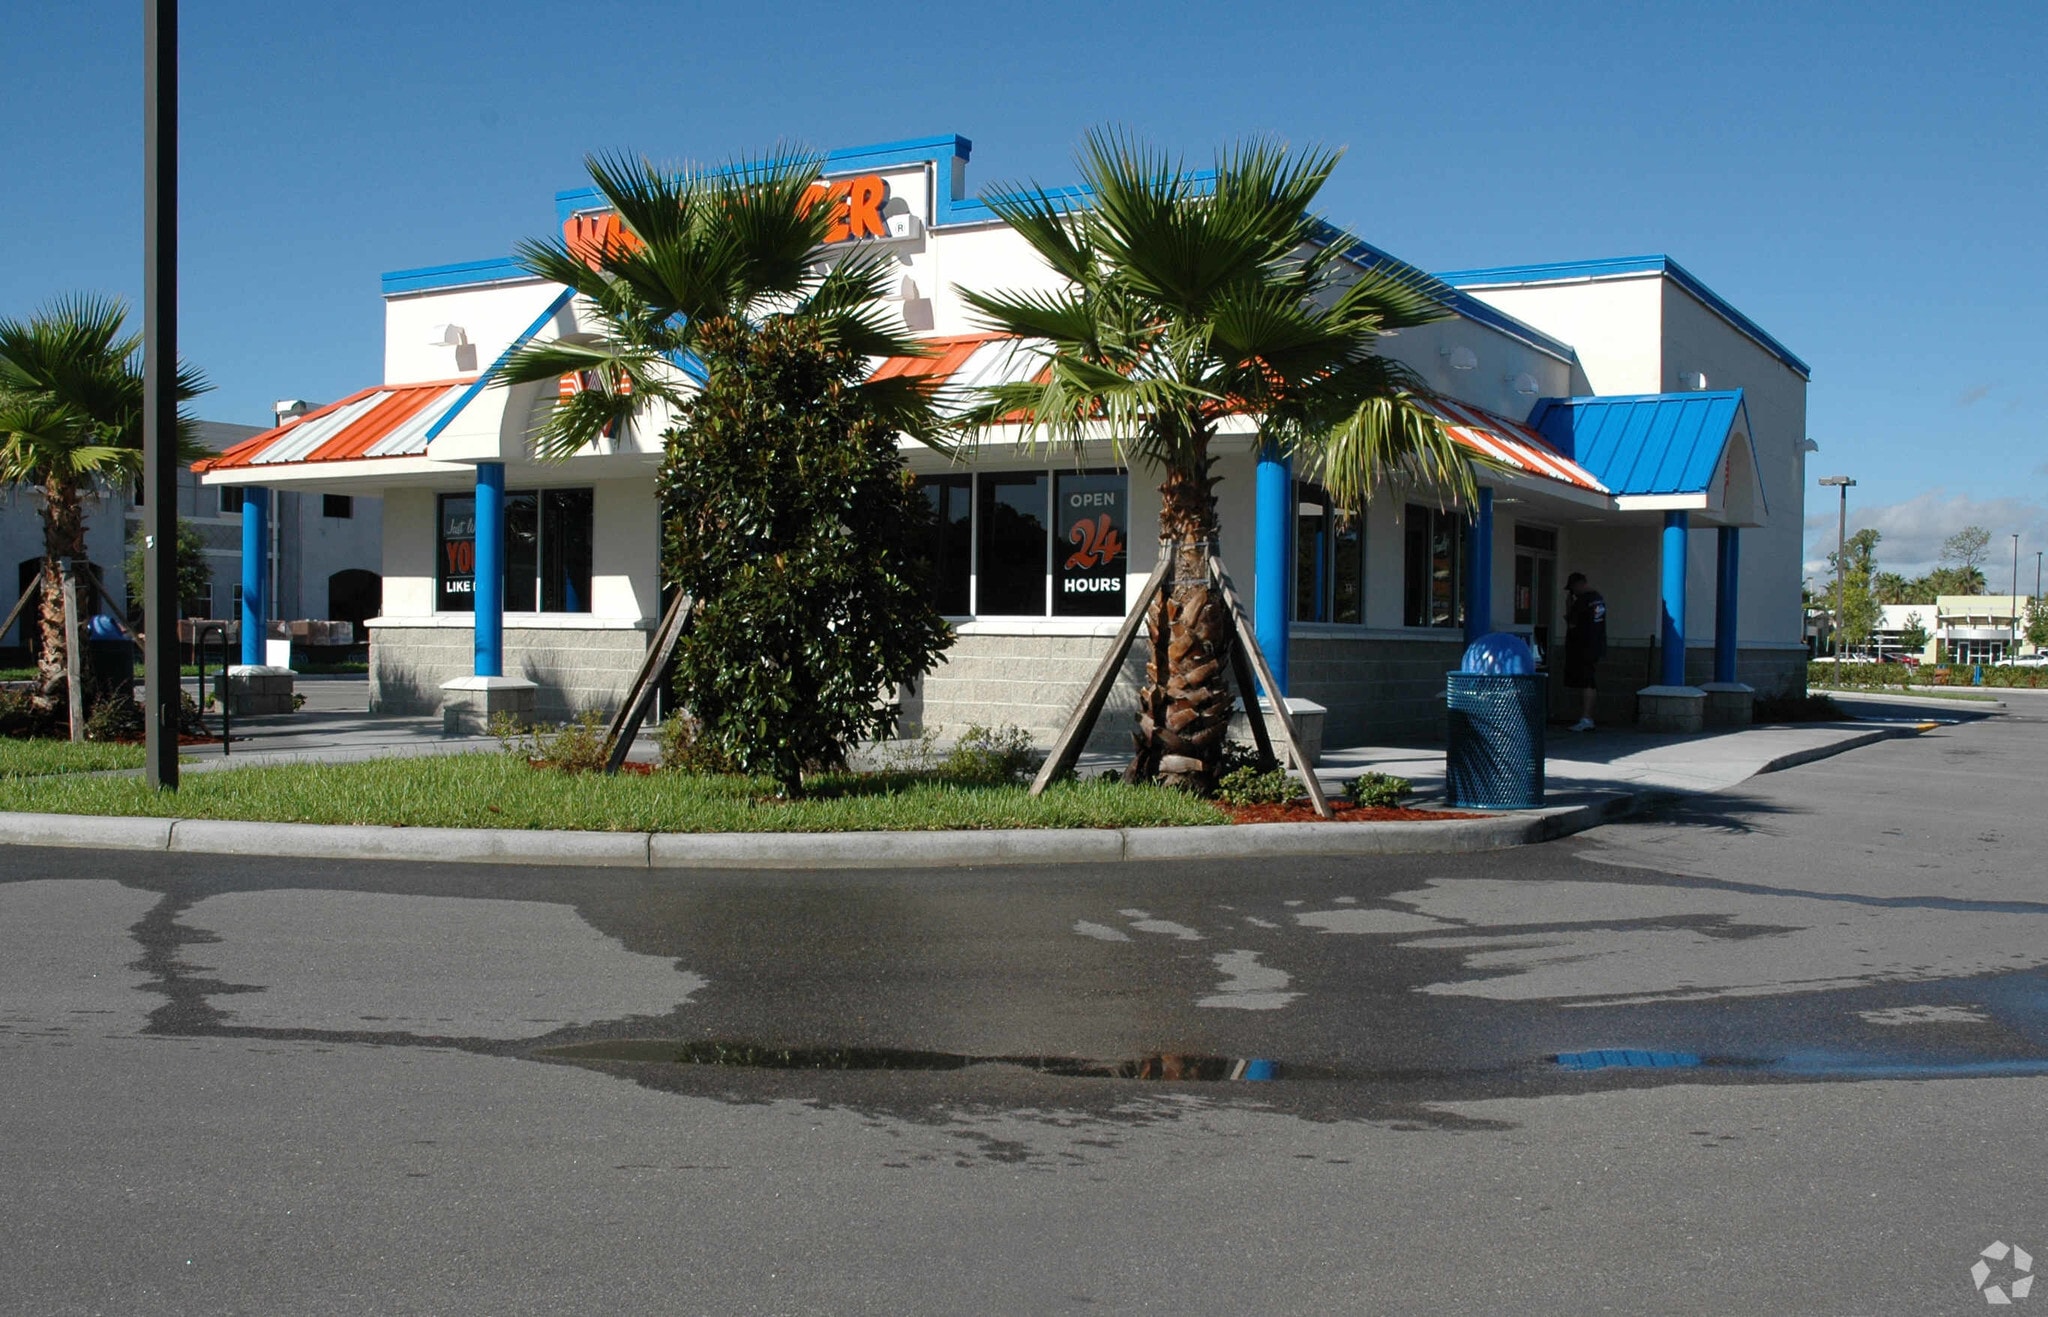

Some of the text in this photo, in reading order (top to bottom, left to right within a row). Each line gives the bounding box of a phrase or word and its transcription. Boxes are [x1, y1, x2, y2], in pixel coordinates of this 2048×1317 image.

[1070, 491, 1115, 507] OPEN
[1063, 512, 1122, 570] 24
[446, 540, 475, 574] YO
[446, 580, 471, 593] LIKE
[1064, 577, 1121, 592] HOURS
